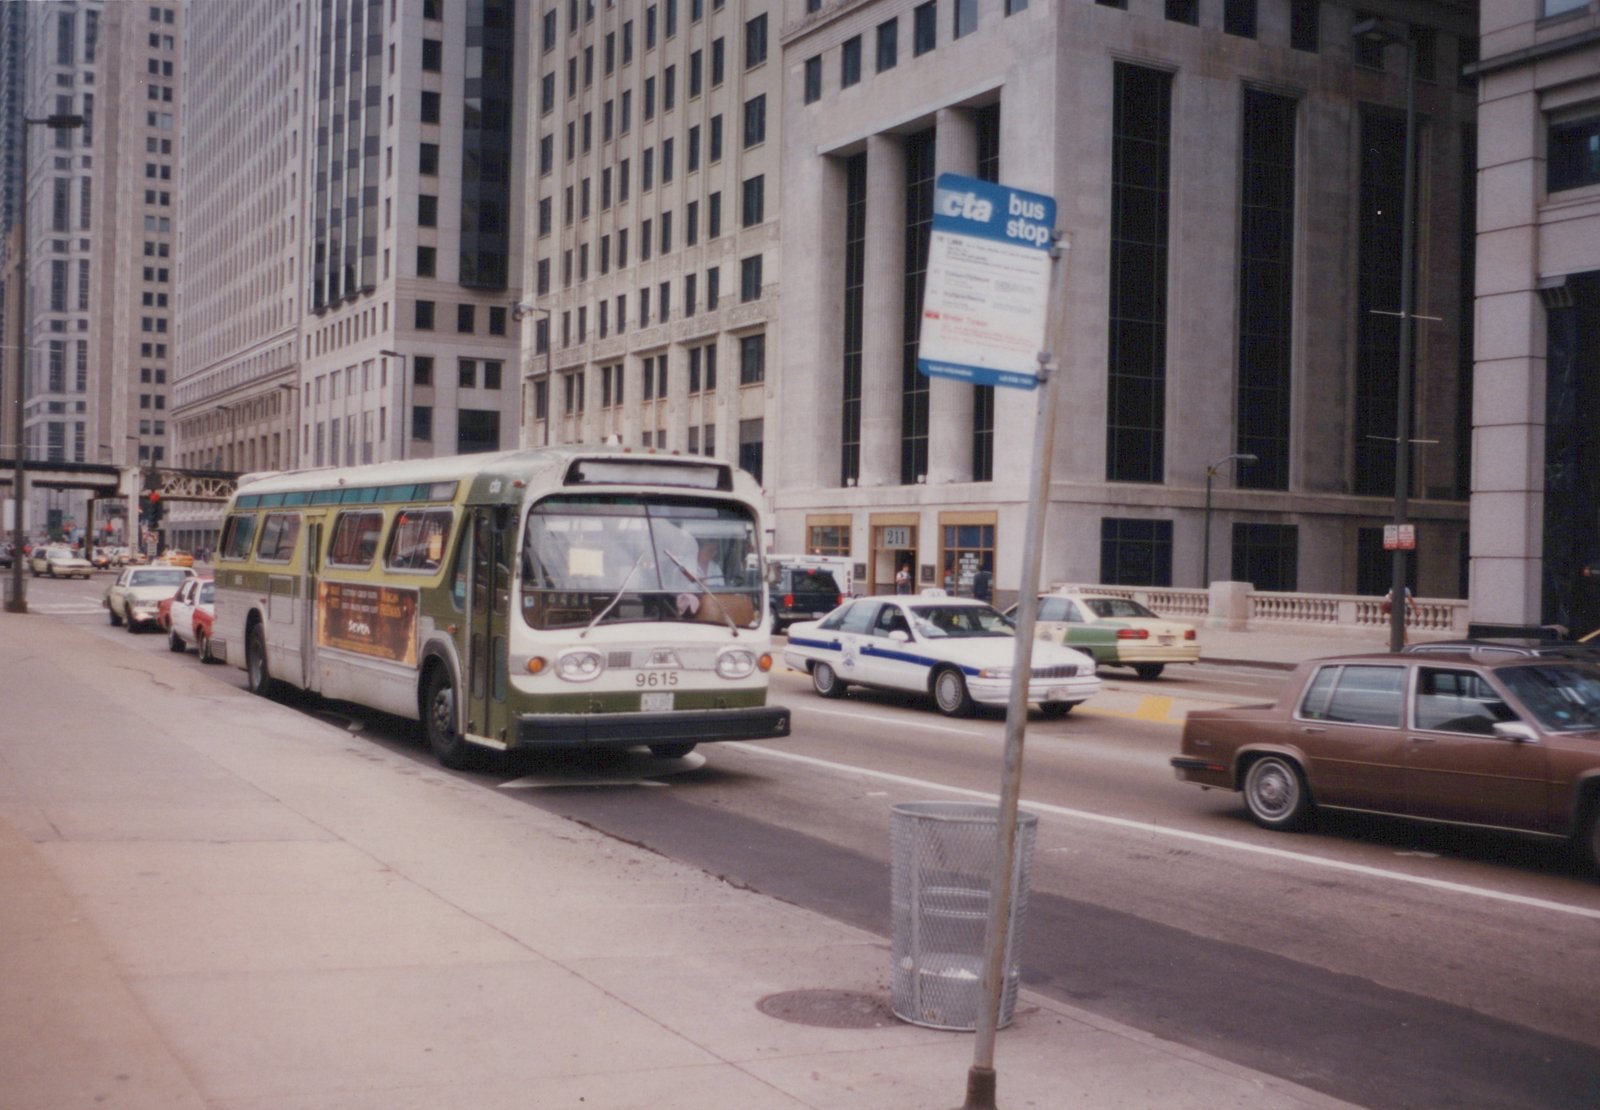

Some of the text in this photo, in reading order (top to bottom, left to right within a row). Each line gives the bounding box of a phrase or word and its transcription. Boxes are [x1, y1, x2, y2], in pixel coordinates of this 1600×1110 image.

[943, 192, 993, 222] cta
[1009, 193, 1045, 220] bus
[1006, 218, 1049, 246] stop
[887, 530, 905, 545] 211
[635, 671, 679, 687] 9615
